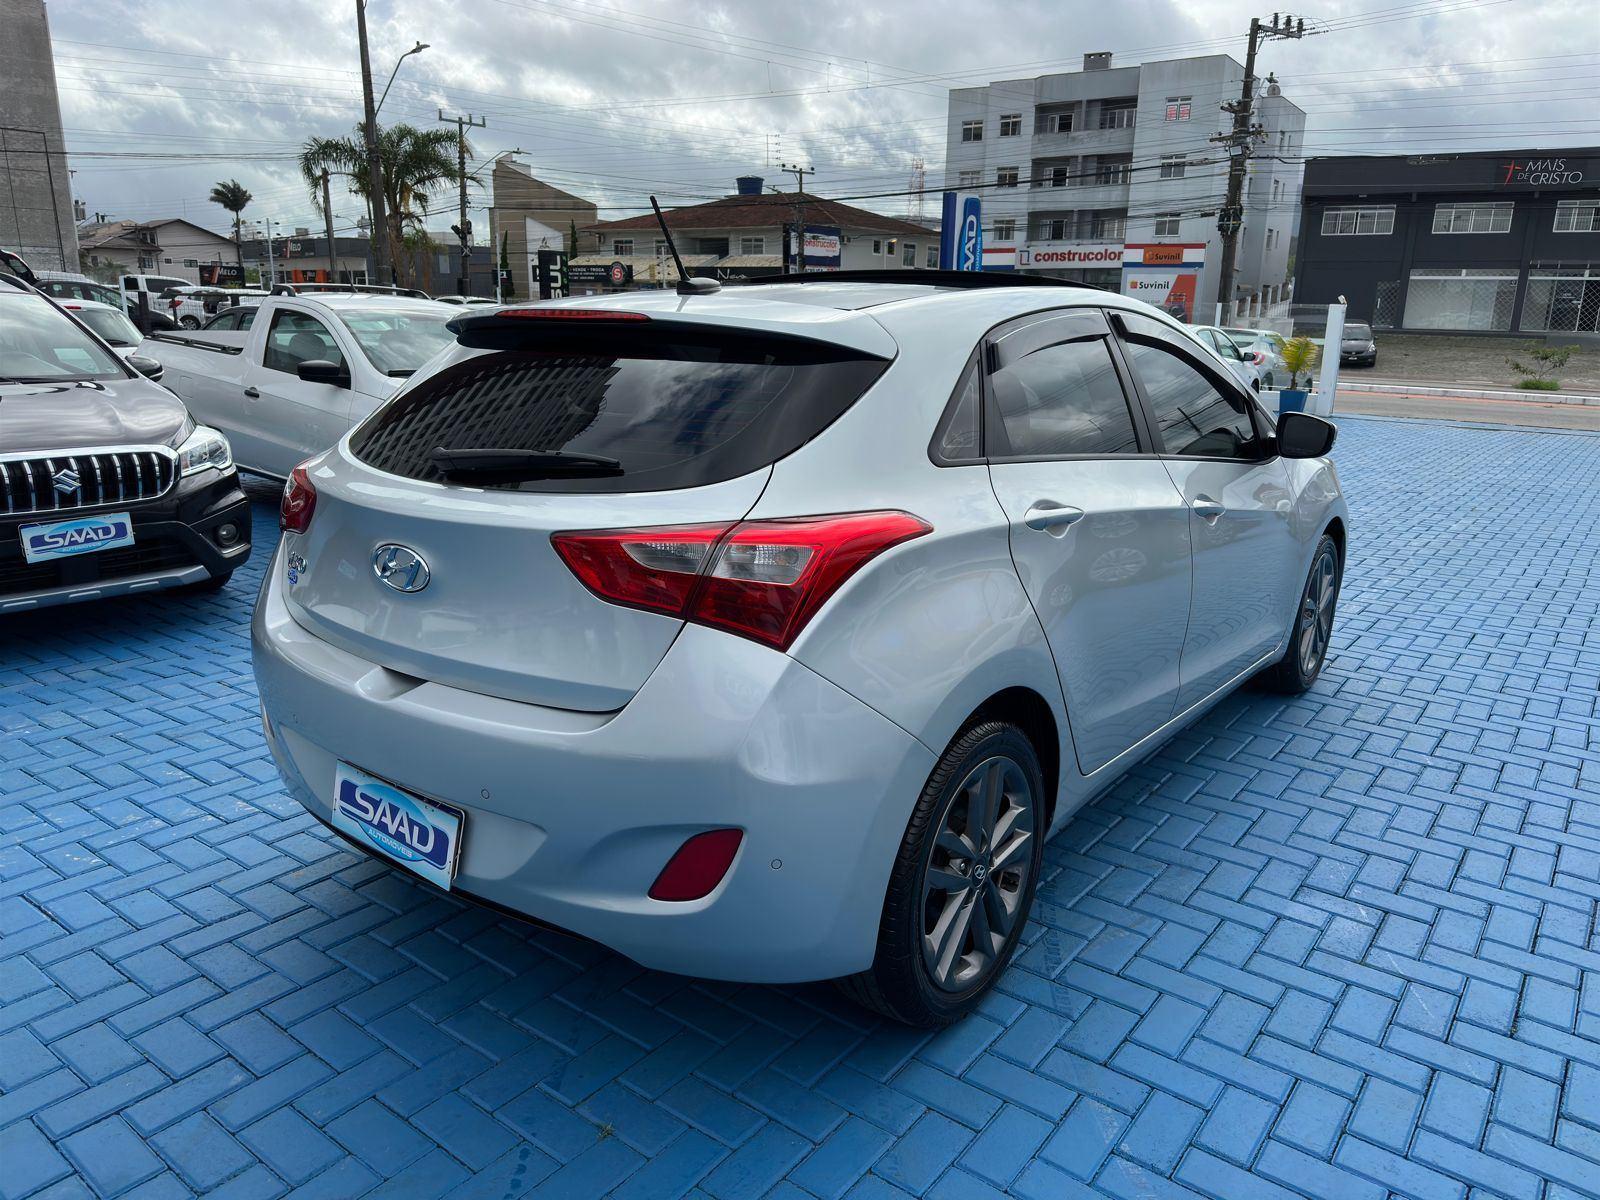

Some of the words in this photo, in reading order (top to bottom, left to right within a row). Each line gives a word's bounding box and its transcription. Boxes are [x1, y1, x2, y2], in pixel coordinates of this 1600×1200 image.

[1526, 159, 1567, 171] MAIS
[1517, 172, 1530, 180] DE
[1529, 171, 1583, 185] CRISTO
[1034, 249, 1123, 262] construcolor
[1155, 253, 1180, 261] Suvinil
[1138, 280, 1170, 290] Suvinil
[42, 524, 116, 550] SAAD
[354, 786, 435, 854] SAAD
